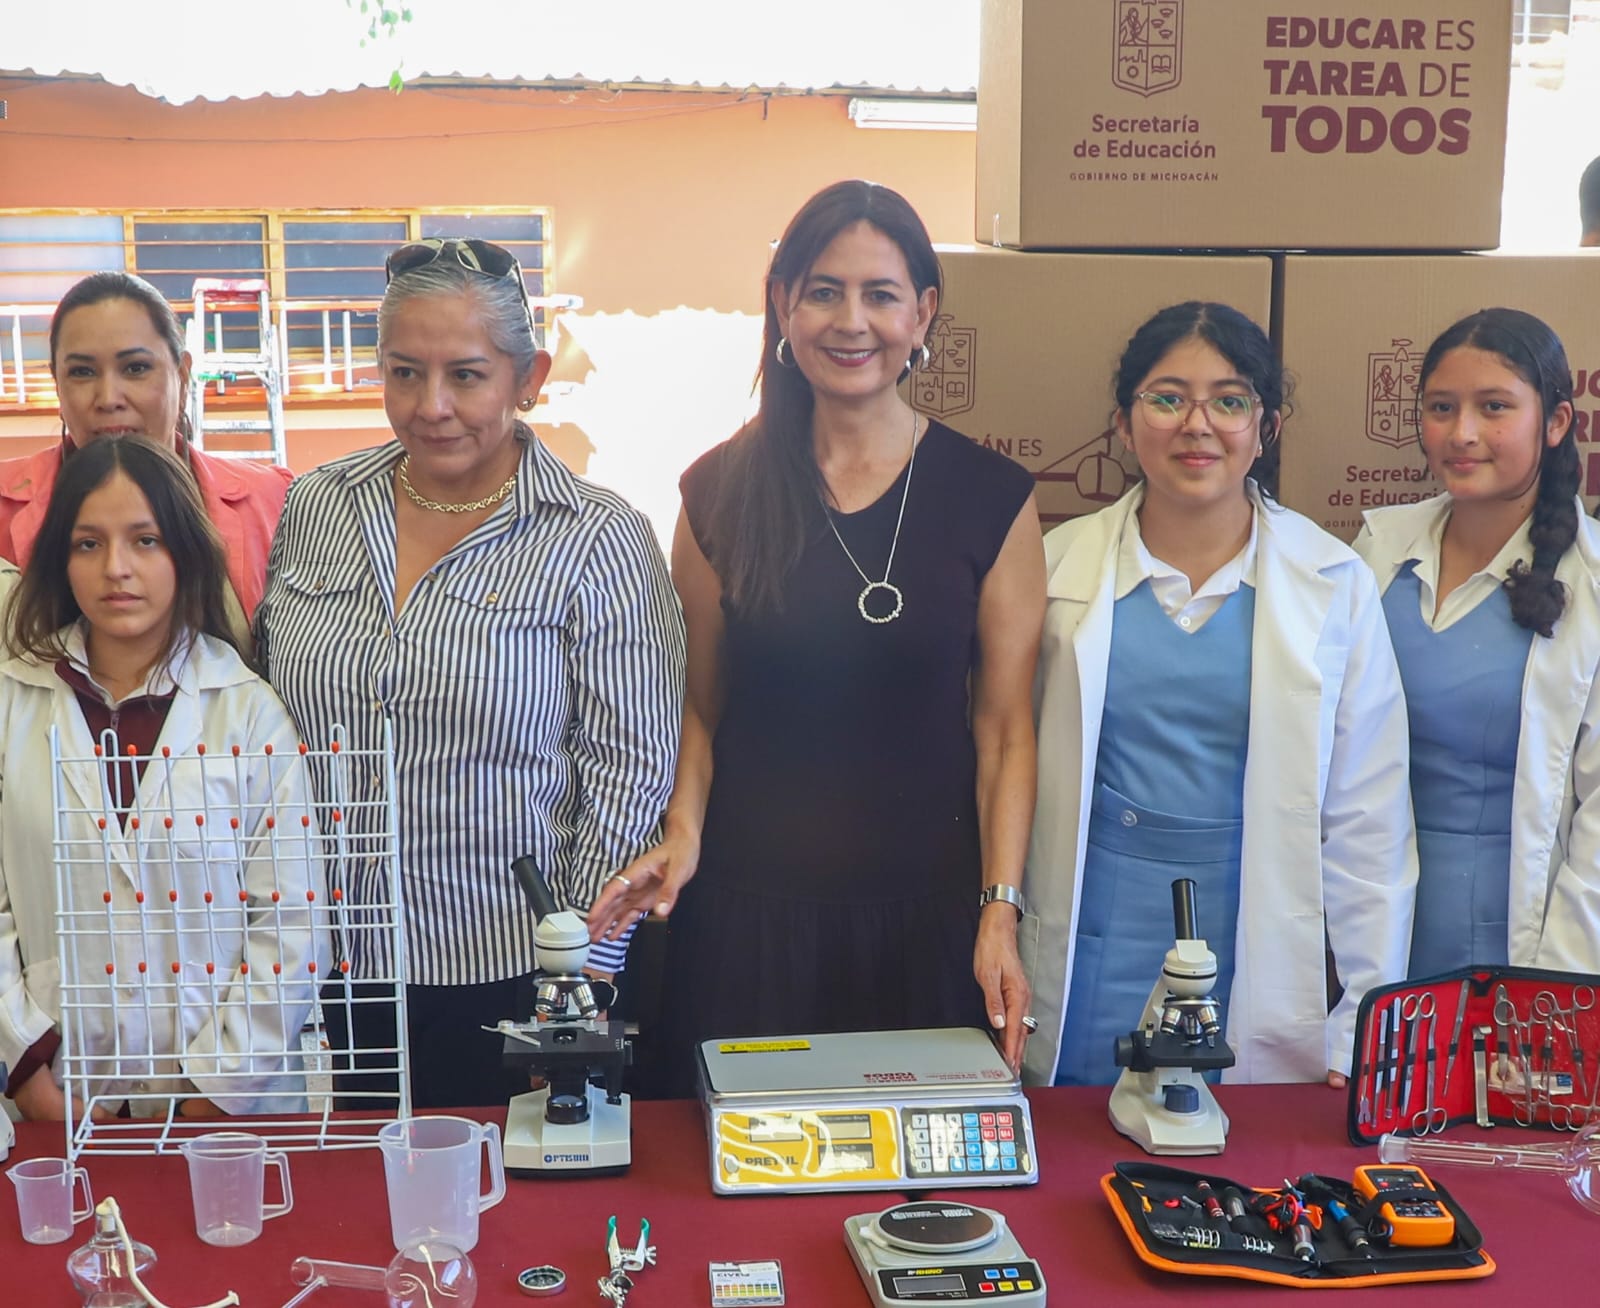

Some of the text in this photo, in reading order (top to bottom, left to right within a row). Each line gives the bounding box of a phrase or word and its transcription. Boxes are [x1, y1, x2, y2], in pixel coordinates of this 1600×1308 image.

[1266, 16, 1475, 51] EDUCAR ES
[1263, 60, 1470, 98] TAREA DE
[1091, 114, 1200, 135] Secretaría
[1261, 105, 1472, 155] TODOS
[1073, 138, 1217, 159] de Educación
[1069, 171, 1220, 182] GOBIERNO DE MICHOACÁN
[1018, 438, 1043, 457] ES
[1327, 488, 1354, 507] de
